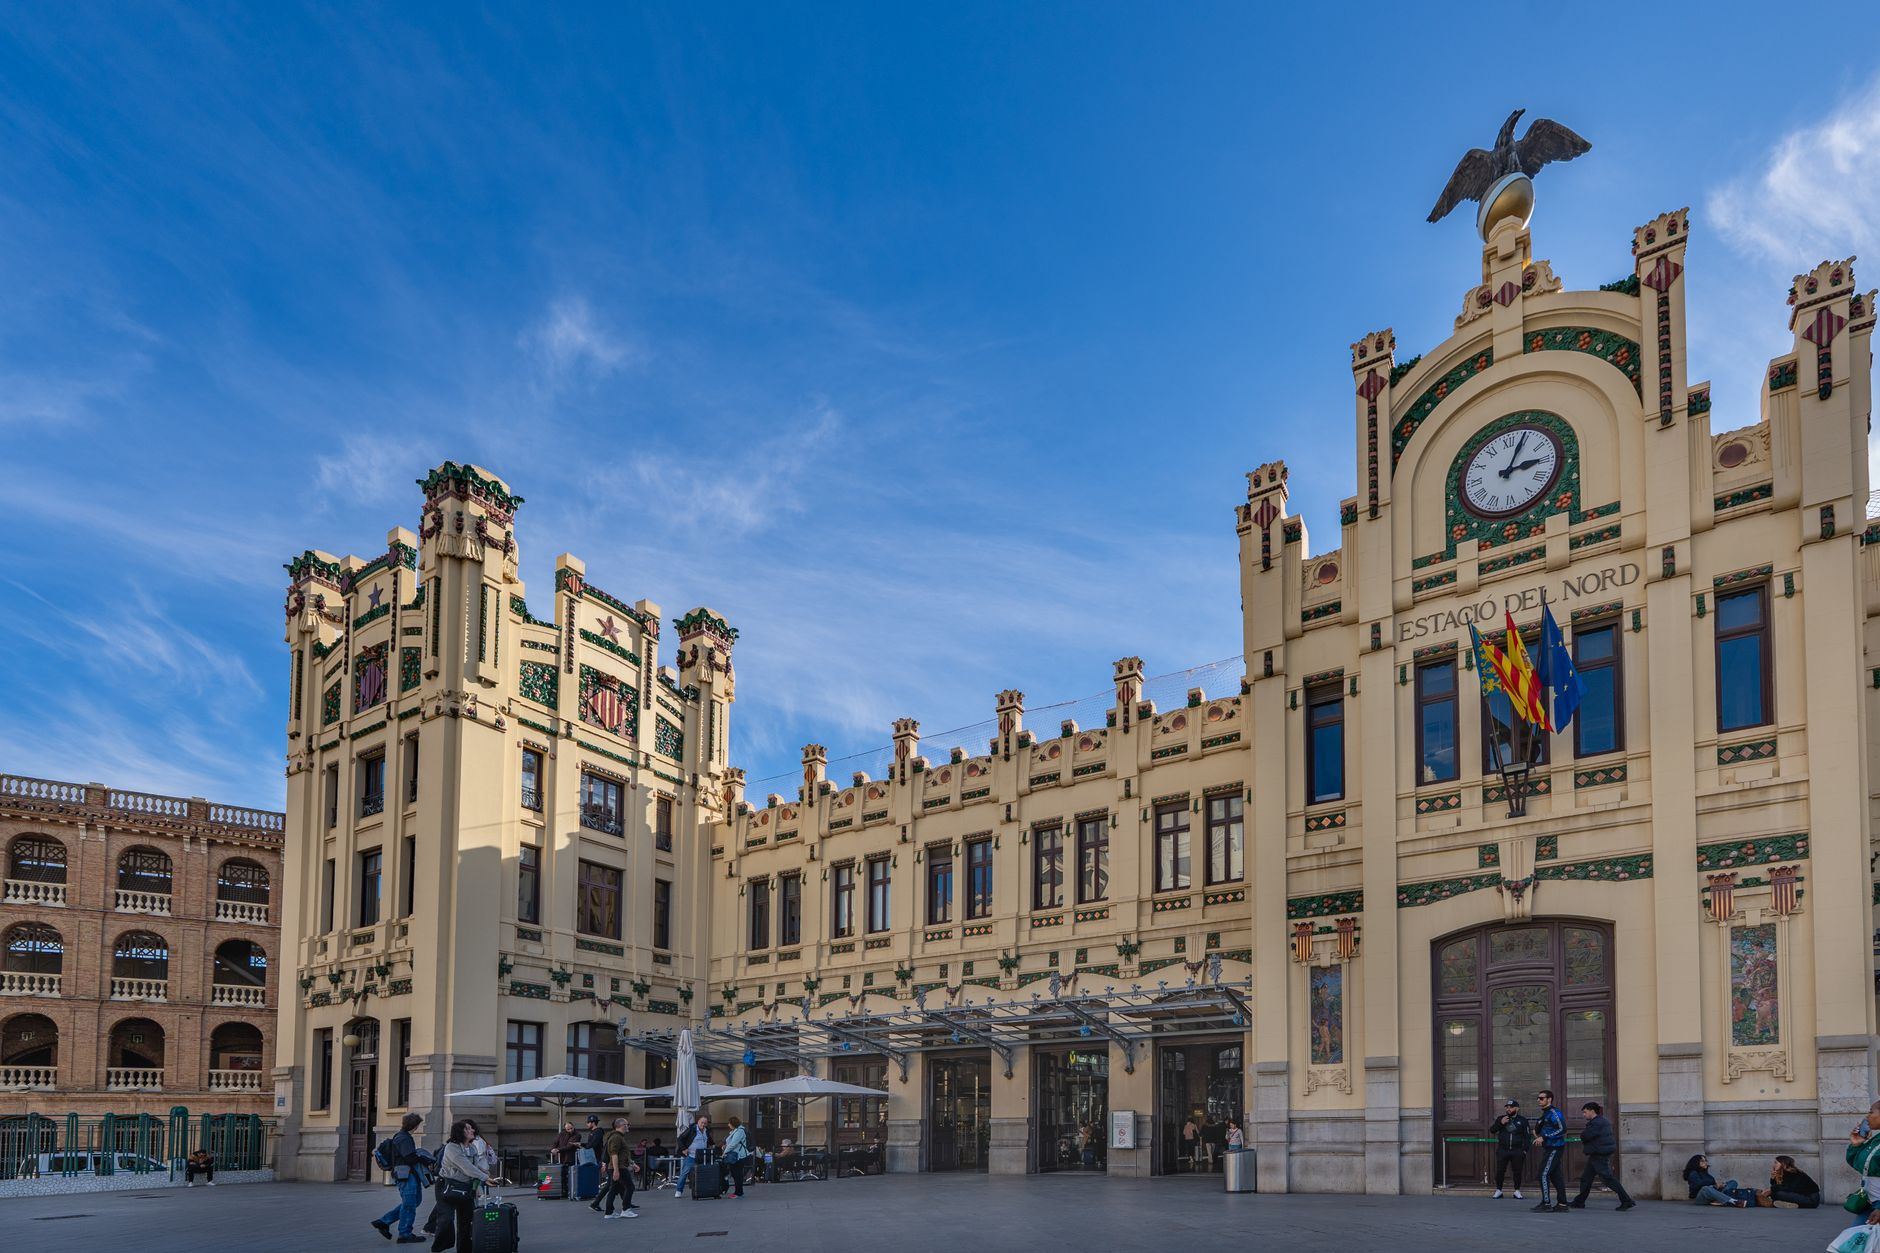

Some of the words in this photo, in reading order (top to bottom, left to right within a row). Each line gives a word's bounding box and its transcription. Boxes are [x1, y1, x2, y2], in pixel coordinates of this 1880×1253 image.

[1502, 436, 1516, 450] XII
[1532, 442, 1545, 452] II
[1486, 446, 1498, 458] XI
[1524, 487, 1533, 496] V
[1398, 594, 1497, 643] ESTACIÓ
[1504, 586, 1557, 615] DEL
[1562, 562, 1640, 601] NORD
